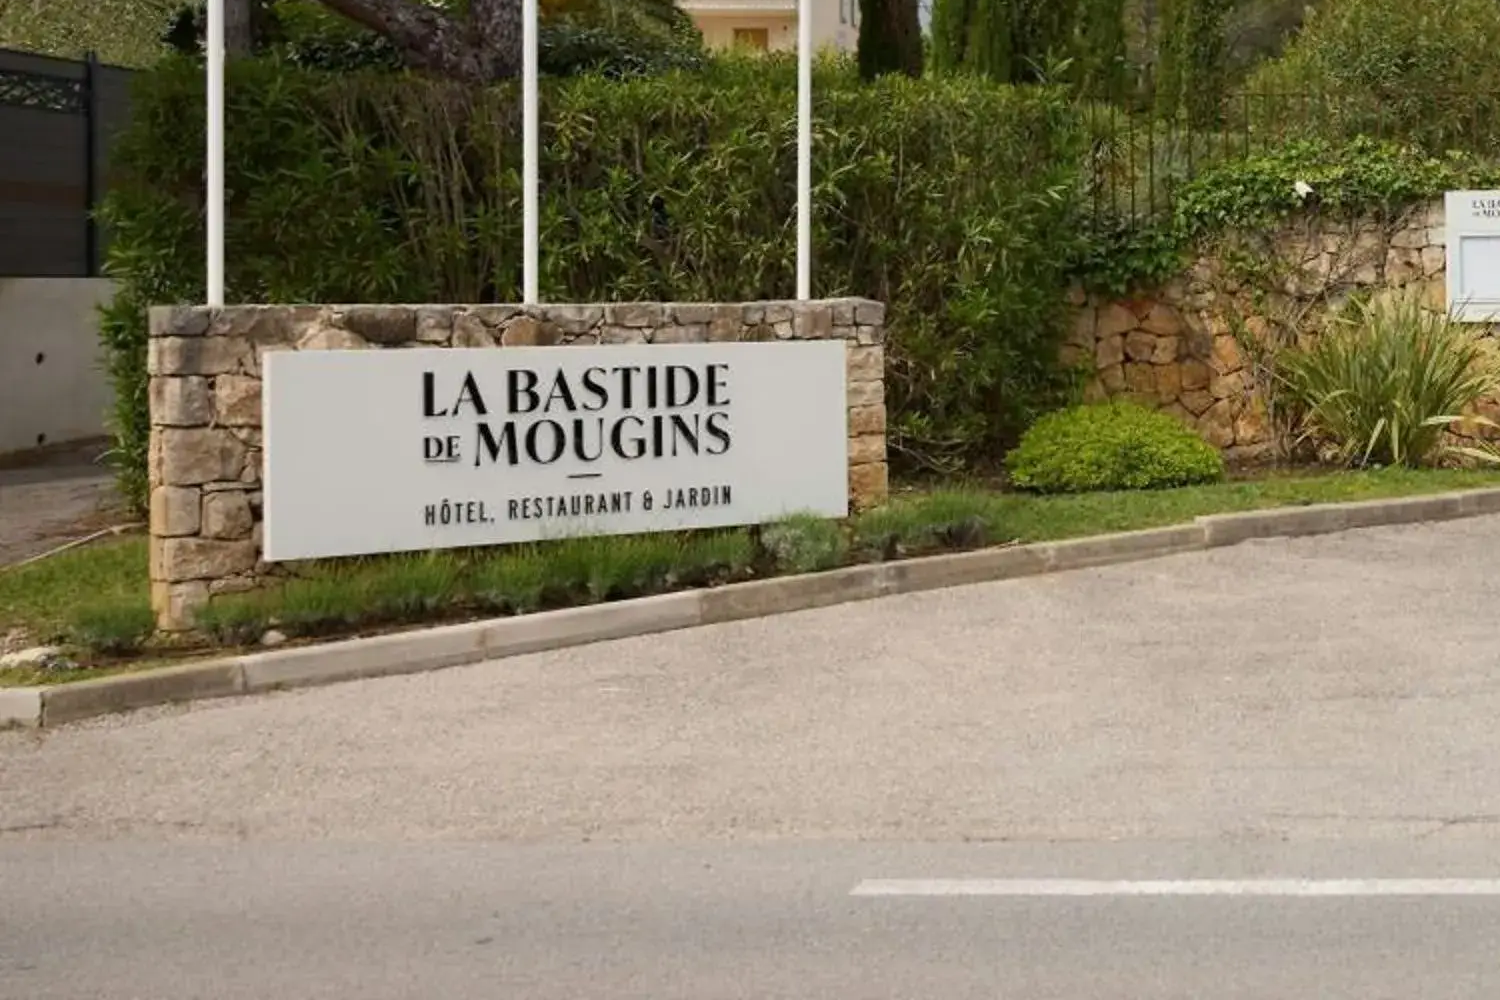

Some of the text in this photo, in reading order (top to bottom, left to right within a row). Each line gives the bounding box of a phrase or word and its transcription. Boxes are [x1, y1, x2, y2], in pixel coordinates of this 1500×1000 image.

[422, 364, 731, 417] LA BASTIDE
[423, 412, 731, 467] DE MOUGINS
[508, 490, 632, 521] RESTAURANT
[642, 490, 653, 511] &
[663, 486, 732, 509] JARDIN
